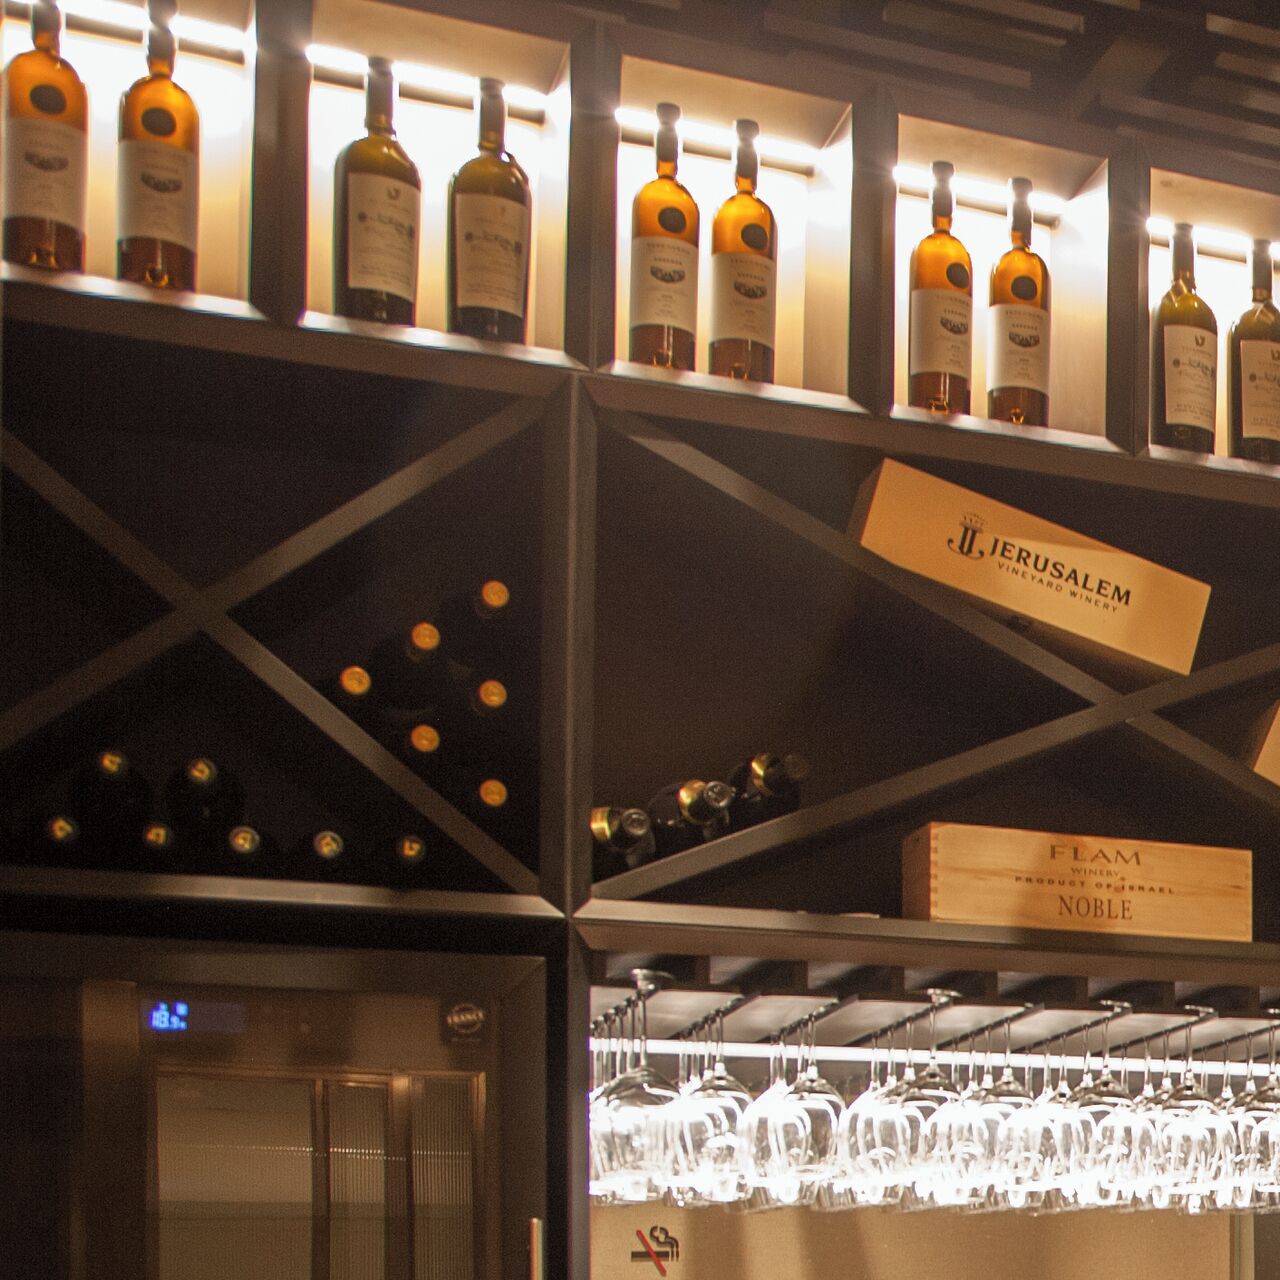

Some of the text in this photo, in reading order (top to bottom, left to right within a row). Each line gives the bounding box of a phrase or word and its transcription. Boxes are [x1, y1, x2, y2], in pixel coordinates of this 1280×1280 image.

[989, 536, 1132, 606] JERUSALEM
[998, 561, 1118, 613] VINEYARD WINERY
[1050, 844, 1141, 866] FLAM
[1071, 867, 1121, 878] WINERY
[1015, 876, 1176, 895] PRODUCT OF ISRAEL
[1058, 895, 1133, 921] NOBLE
